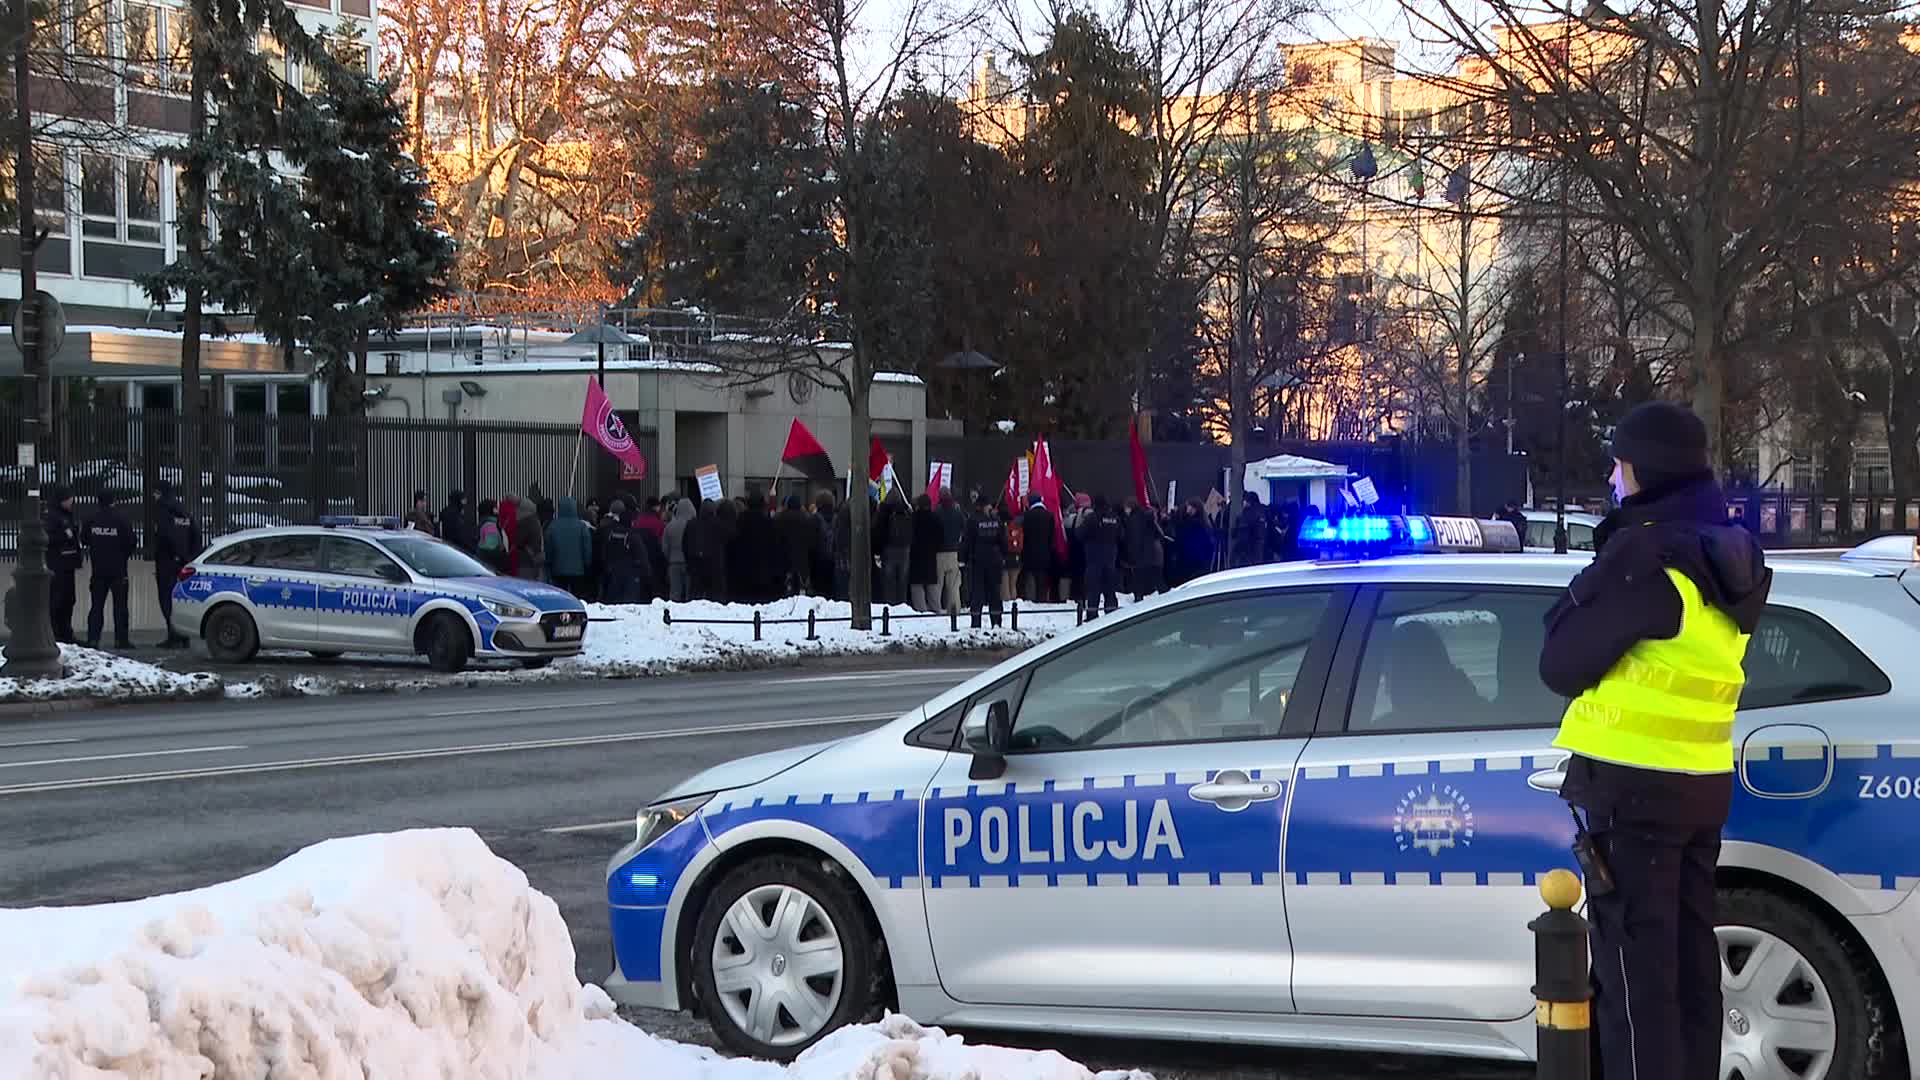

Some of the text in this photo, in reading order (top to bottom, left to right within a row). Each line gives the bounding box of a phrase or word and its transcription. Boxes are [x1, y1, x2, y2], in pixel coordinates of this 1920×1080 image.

[1438, 518, 1481, 546] POLICJA
[342, 591, 397, 609] POLICJA
[943, 799, 1185, 865] POLICJA
